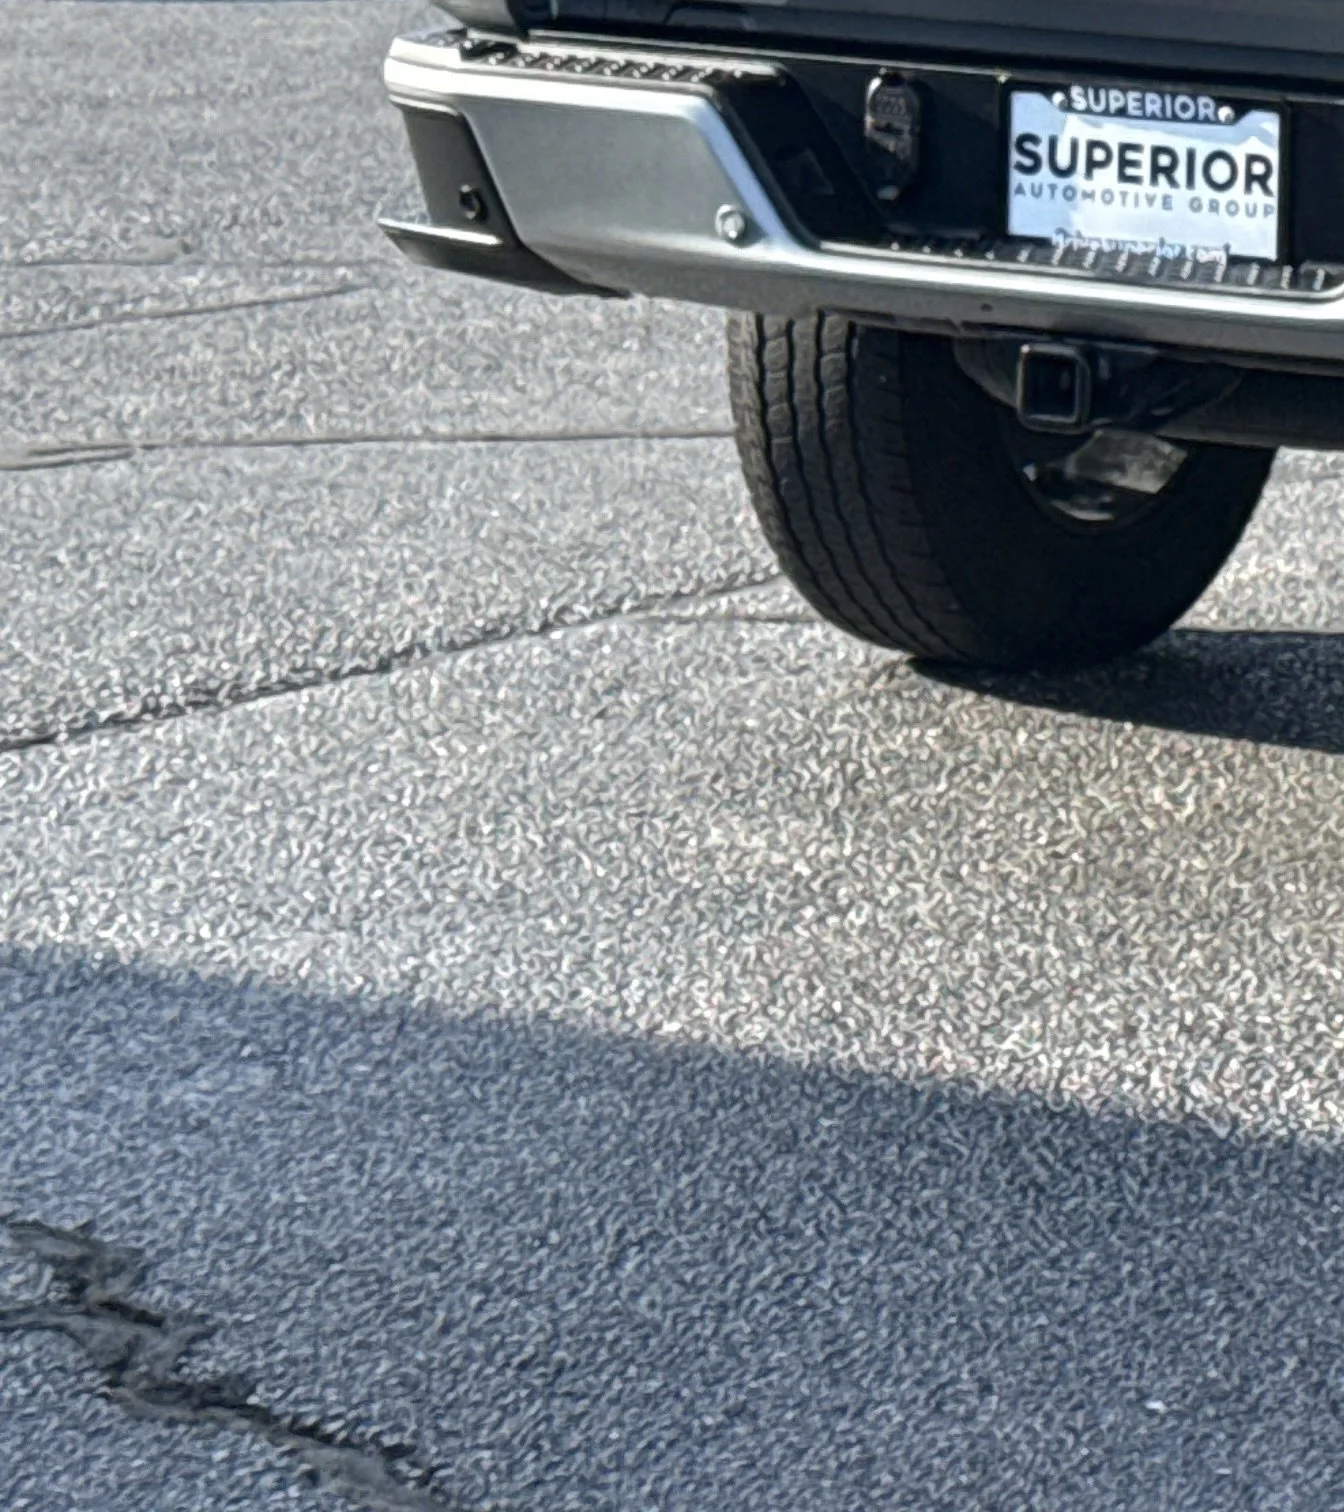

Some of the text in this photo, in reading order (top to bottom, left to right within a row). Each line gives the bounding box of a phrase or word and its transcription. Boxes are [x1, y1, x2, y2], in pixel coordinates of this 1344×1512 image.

[1069, 84, 1217, 122] SUPERIOR
[1013, 132, 1275, 198] SUPERIOR
[1013, 181, 1275, 219] AUTOMOTIVE GROUP
